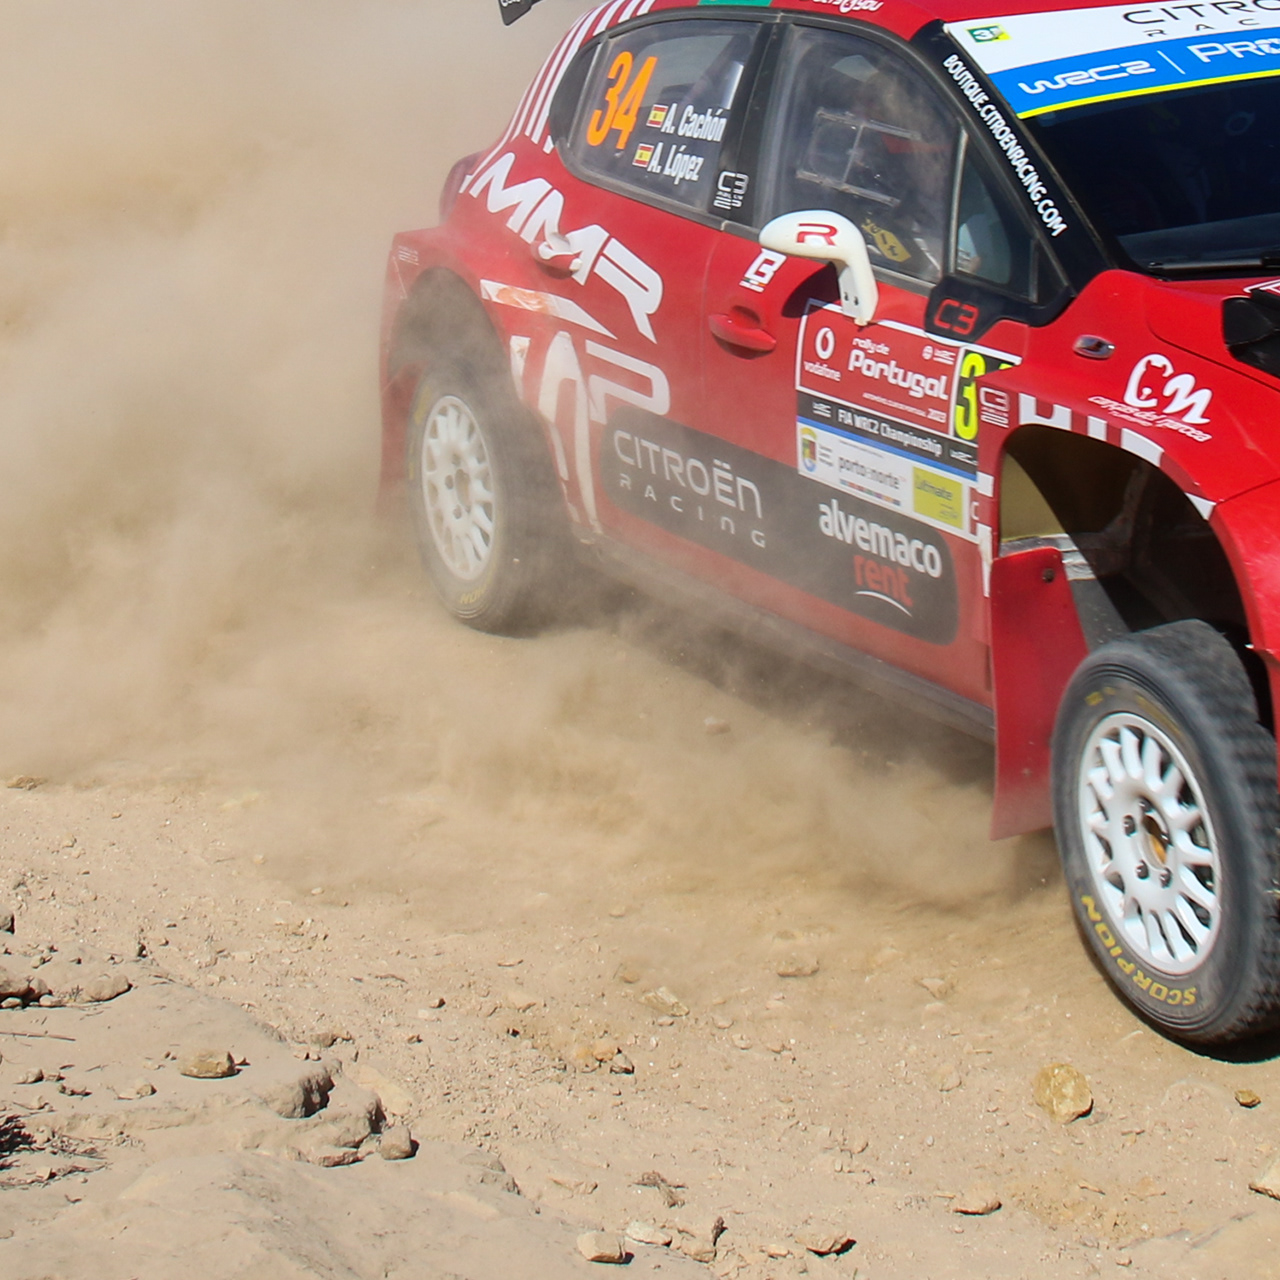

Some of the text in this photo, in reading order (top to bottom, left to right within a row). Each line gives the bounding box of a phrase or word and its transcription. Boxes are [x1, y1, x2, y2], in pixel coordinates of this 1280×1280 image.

[586, 51, 658, 150] 34
[661, 103, 727, 142] A. Cachón
[647, 142, 704, 185] A. López
[943, 54, 1067, 237] BOUTIQUE.CITROENRACING.COM
[716, 170, 750, 196] C3
[796, 223, 838, 246] R
[934, 298, 979, 335] C3
[803, 360, 841, 382] vodafone
[848, 349, 949, 400] Portugal
[838, 408, 853, 424] FIA
[880, 424, 943, 457] Championship
[613, 429, 763, 519] CITROËN
[619, 472, 767, 548] RACING
[818, 498, 942, 579] alvemaco
[853, 555, 914, 607] rent
[1080, 894, 1198, 1007] SCORPION
